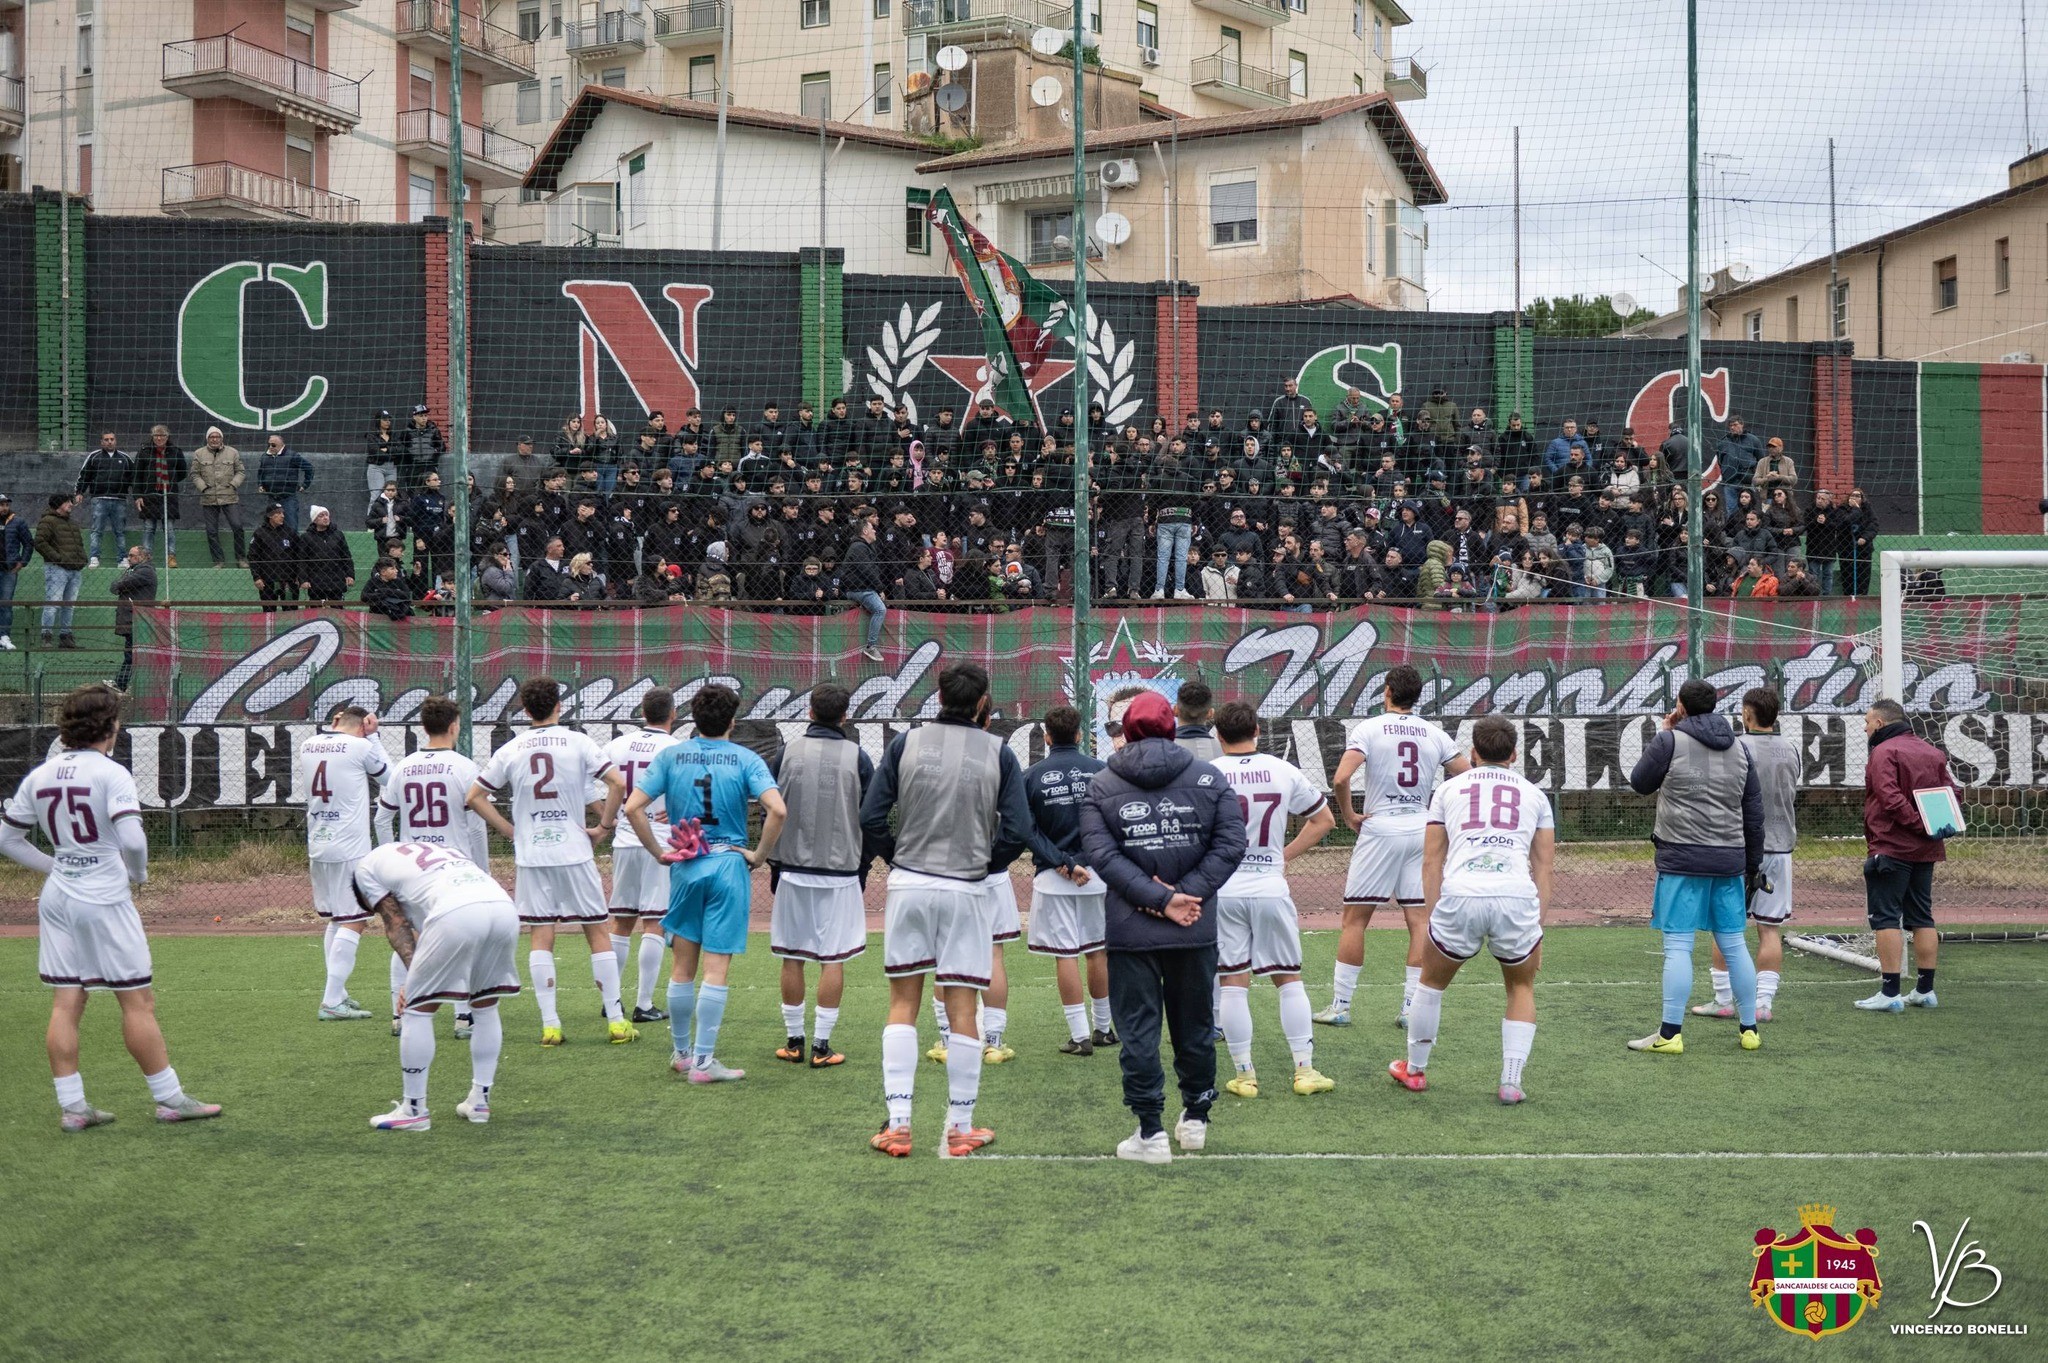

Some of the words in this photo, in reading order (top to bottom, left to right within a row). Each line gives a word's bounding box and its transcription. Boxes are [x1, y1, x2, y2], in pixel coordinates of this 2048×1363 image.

[177, 260, 329, 430] C
[562, 279, 715, 434] N
[1296, 342, 1403, 435] S
[1625, 367, 1731, 495] C
[1383, 724, 1427, 738] FERRIGNO
[302, 743, 347, 753] CALABRESE
[517, 737, 568, 751] PISCIOTTA
[629, 742, 656, 753] ROZZI
[403, 764, 444, 776] FERRIGNO
[447, 764, 454, 776] F.
[1397, 741, 1419, 788] 3
[312, 760, 333, 804] 4
[530, 753, 558, 800] 2
[1241, 770, 1271, 784] MINO
[1468, 772, 1519, 784] MARIANI
[1051, 785, 1069, 793] ZODA
[405, 781, 449, 828] 26
[694, 773, 719, 826] 1
[1399, 794, 1422, 803] ZODA
[541, 810, 568, 818] ZODA
[1460, 783, 1521, 832] 18
[36, 786, 99, 846] 75
[1133, 823, 1157, 833] ZODA
[422, 835, 445, 843] ZODA
[1482, 836, 1514, 846] ZODA
